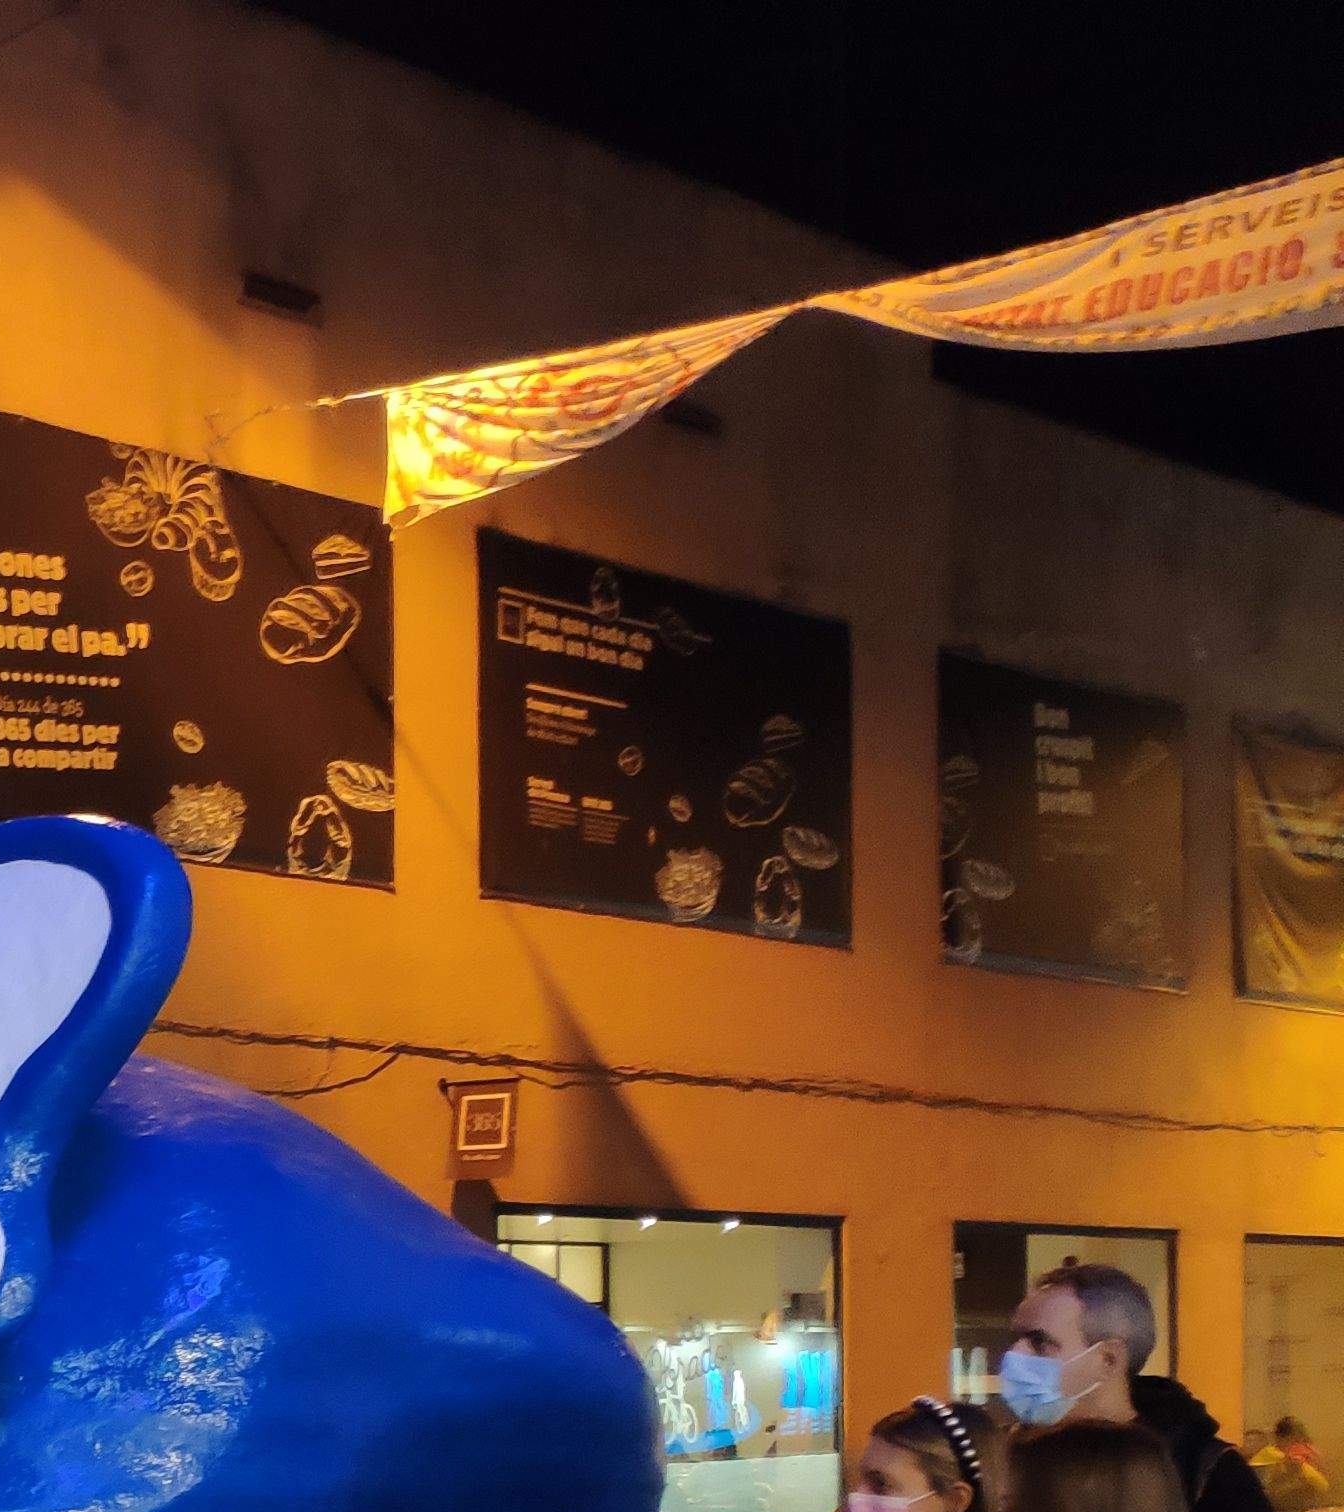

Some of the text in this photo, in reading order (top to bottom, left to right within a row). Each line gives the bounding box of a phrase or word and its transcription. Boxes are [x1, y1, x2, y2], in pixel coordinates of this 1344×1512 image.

[11, 588, 62, 616] per
[51, 623, 79, 653] el
[33, 718, 80, 744] dies
[82, 724, 120, 746] per
[12, 746, 118, 771] compartir
